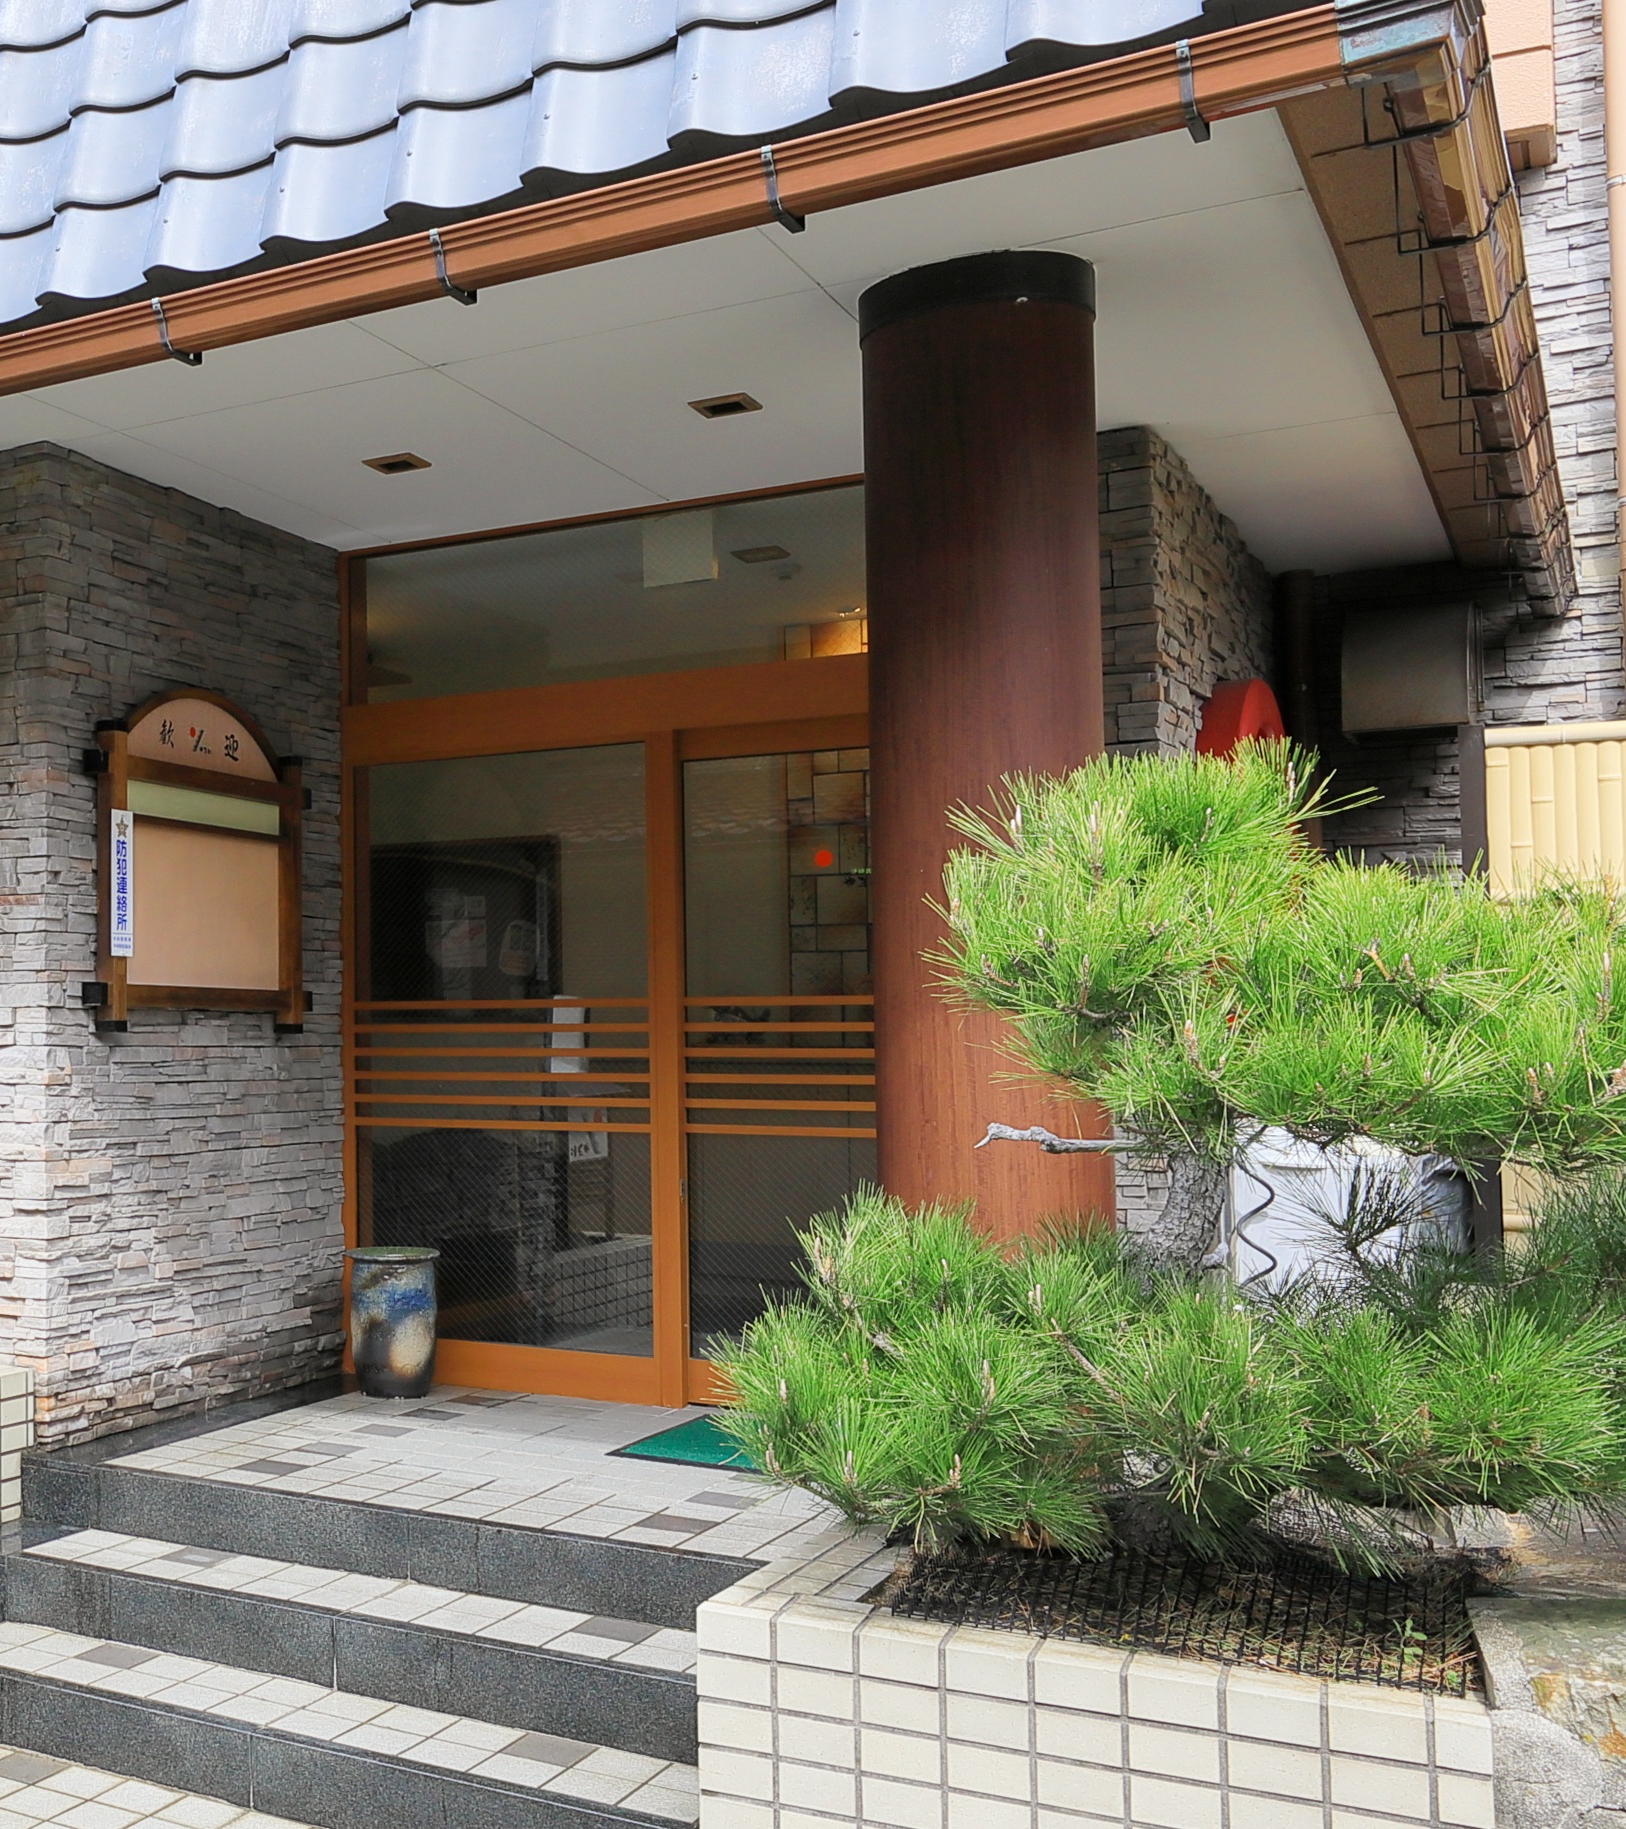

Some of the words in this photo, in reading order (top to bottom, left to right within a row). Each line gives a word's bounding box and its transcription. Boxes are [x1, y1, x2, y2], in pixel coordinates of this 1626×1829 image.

[116, 839, 128, 931] 防犯連絡所
